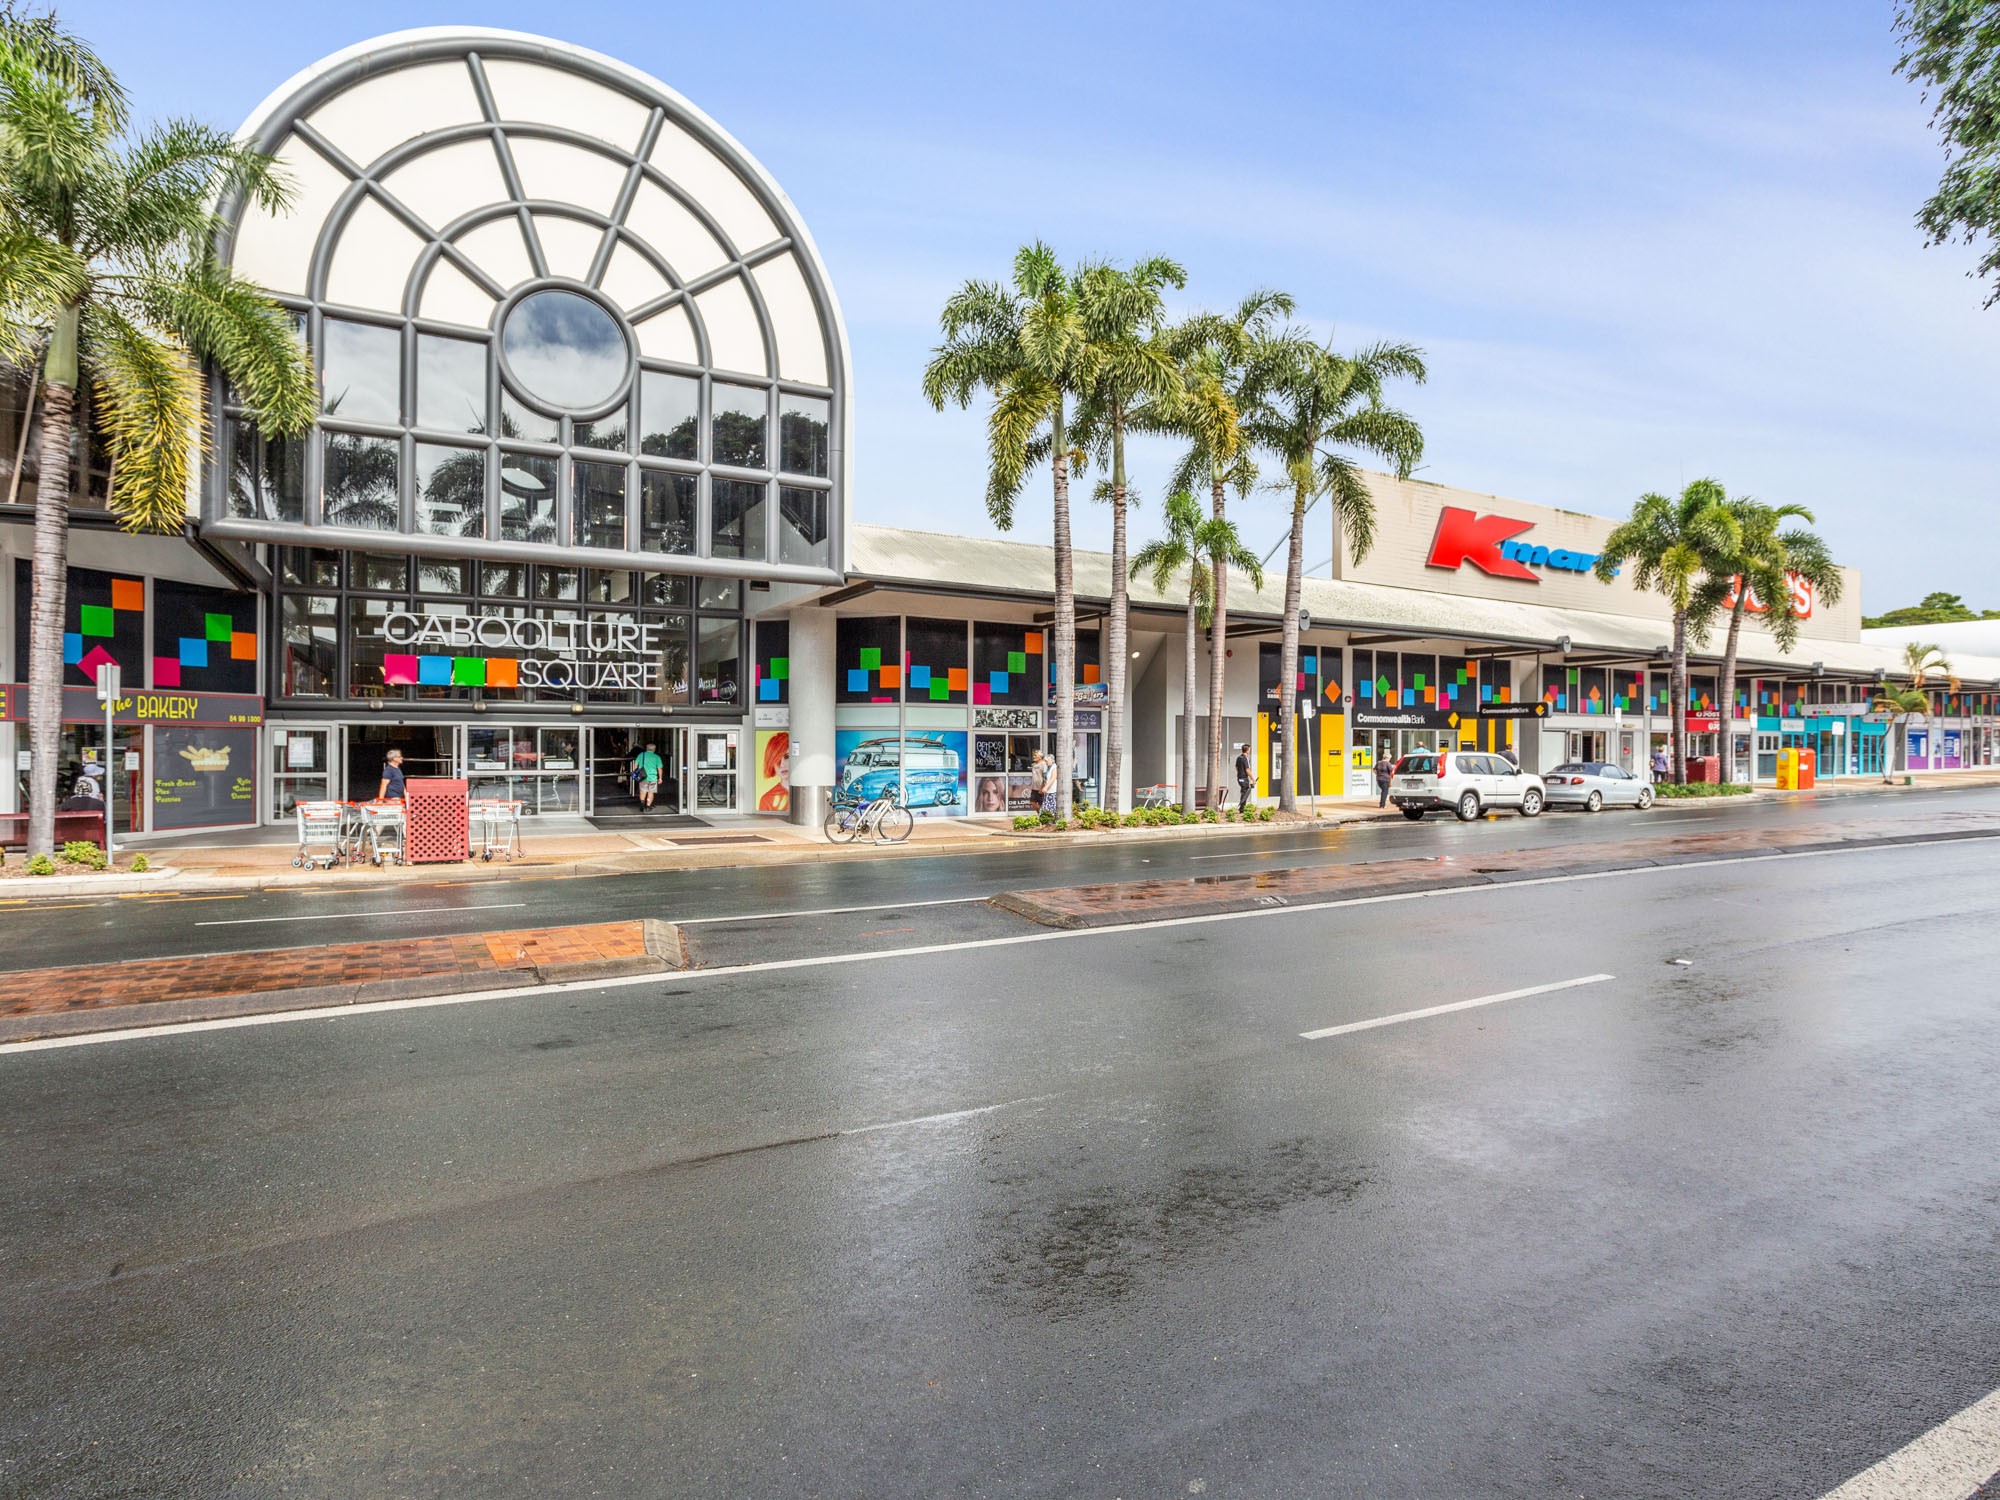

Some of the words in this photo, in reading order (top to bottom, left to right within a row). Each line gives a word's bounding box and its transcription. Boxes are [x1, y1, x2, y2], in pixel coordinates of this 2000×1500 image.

[1425, 506, 1622, 582] Kmar
[383, 612, 662, 655] CABOOLTURE
[519, 658, 662, 691] SQUARE
[137, 695, 199, 719] BAKERY
[1352, 752, 1362, 766] #1
